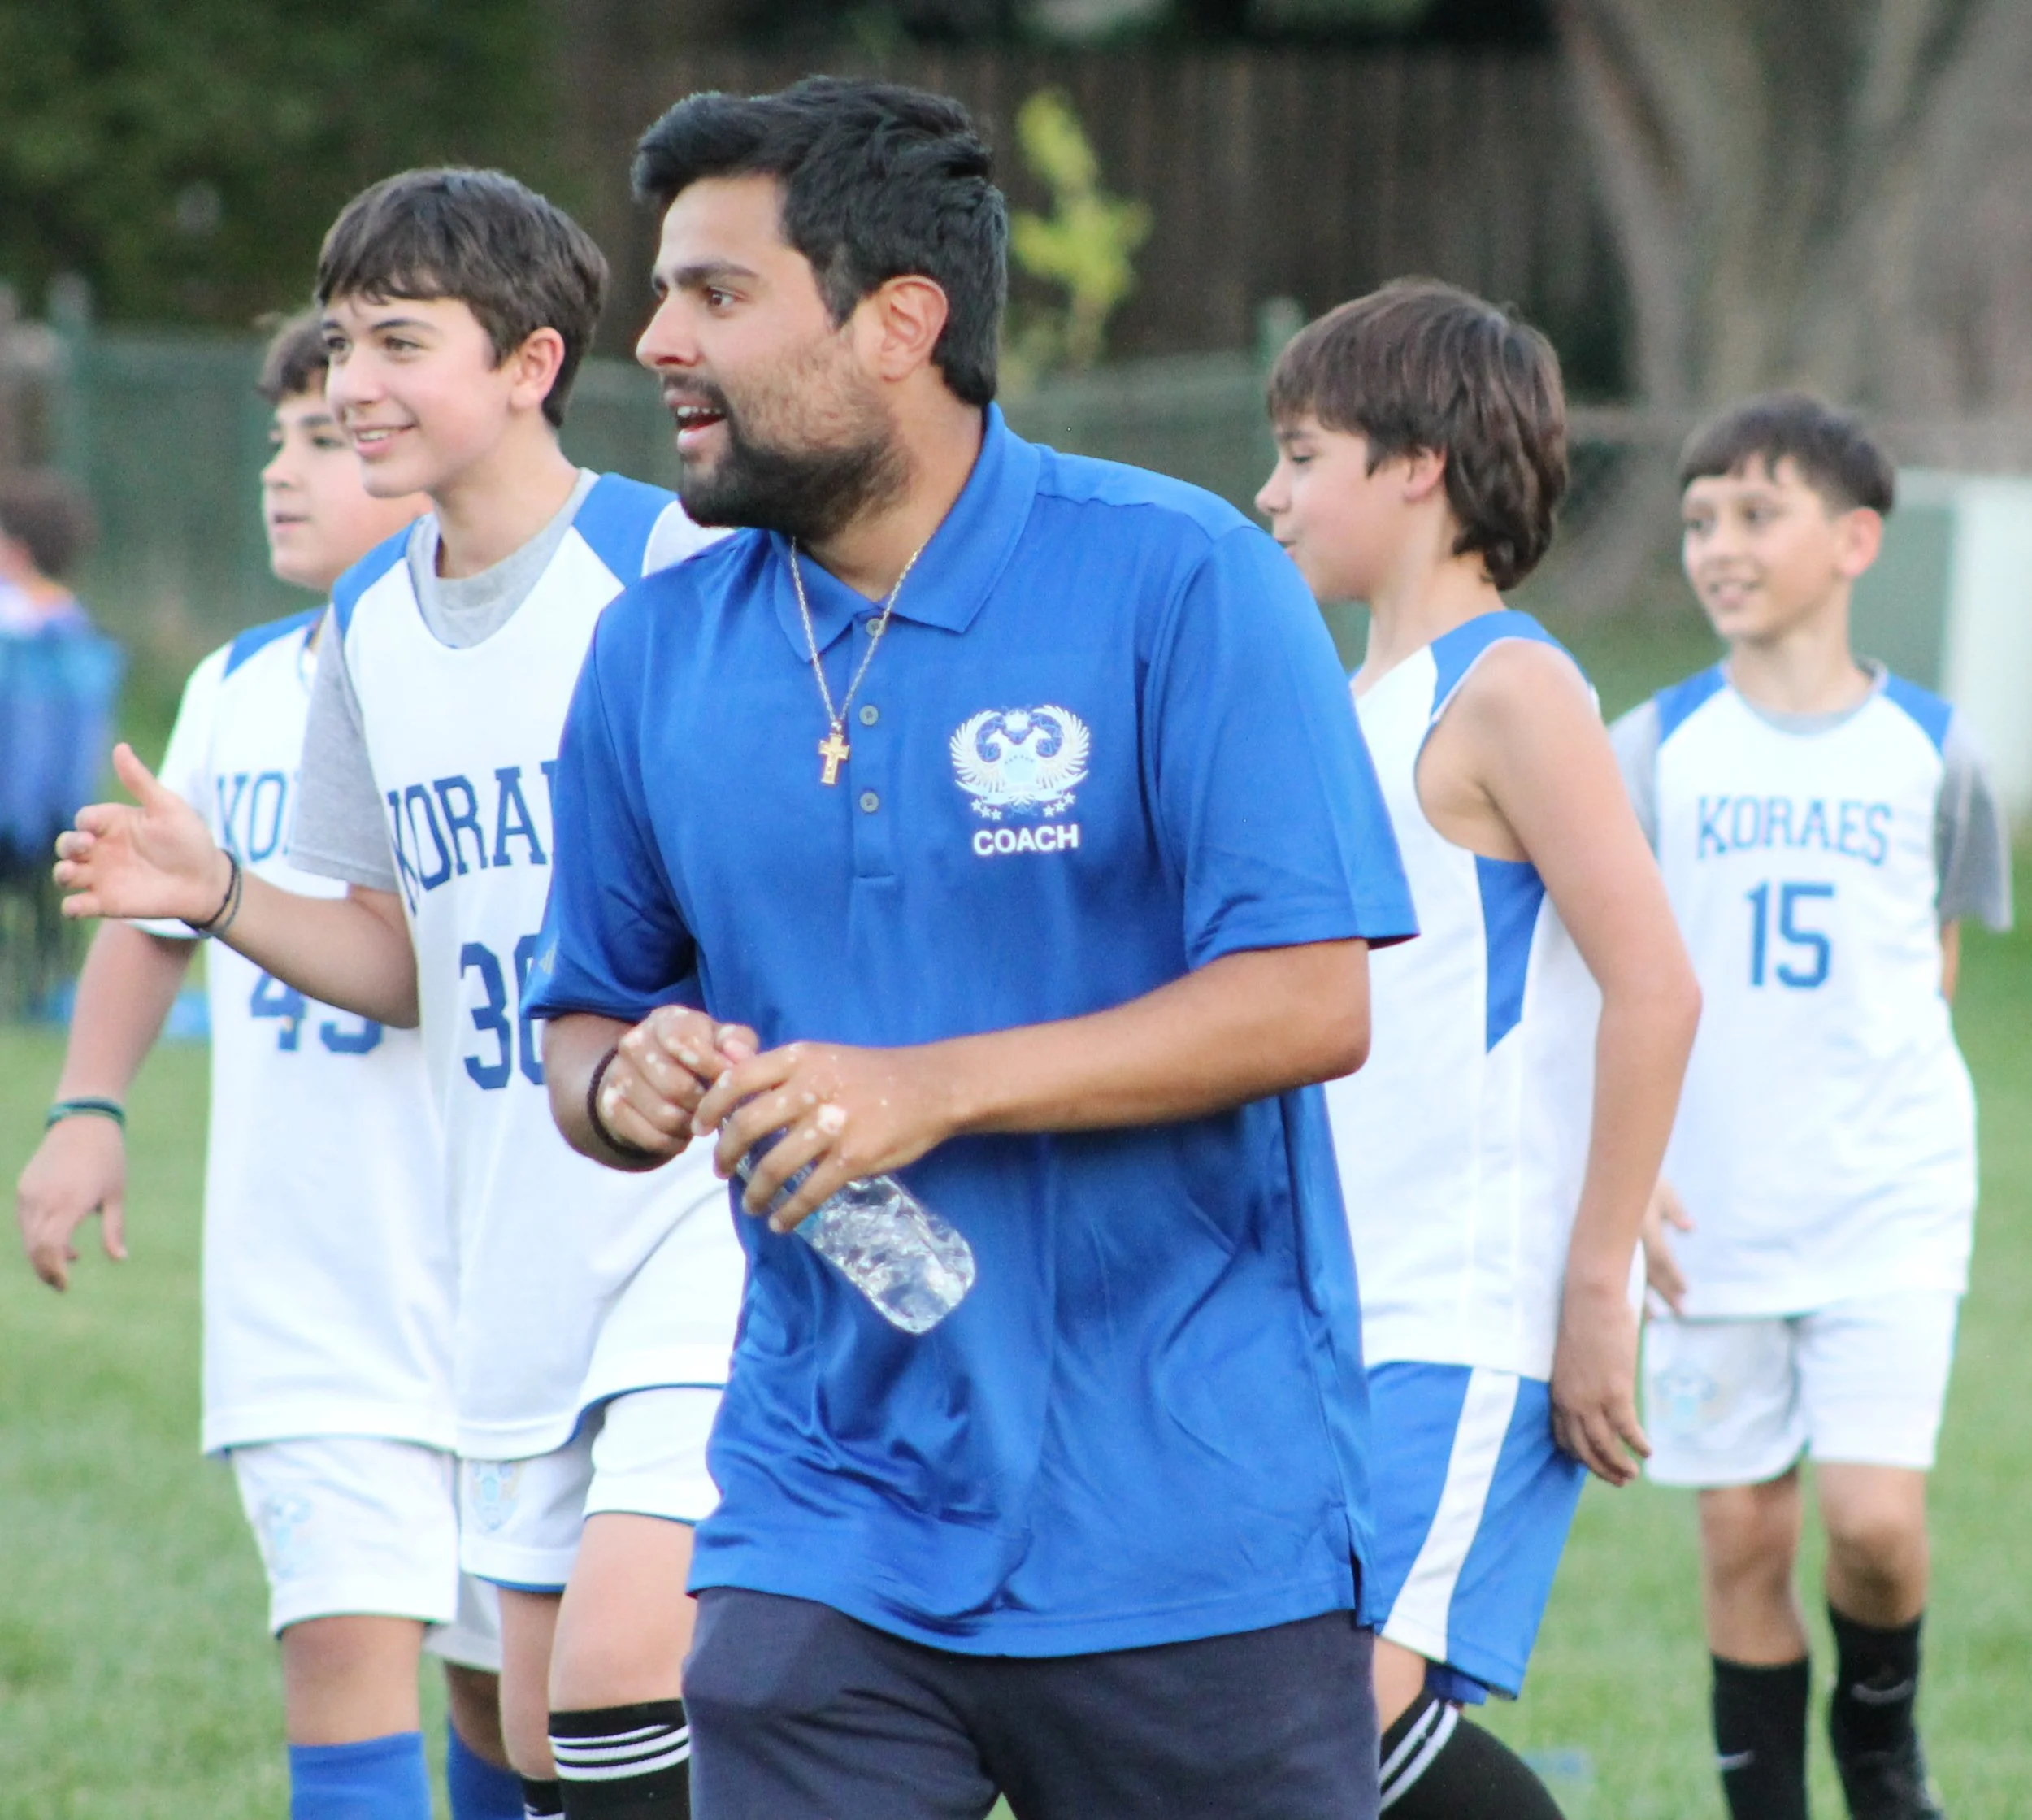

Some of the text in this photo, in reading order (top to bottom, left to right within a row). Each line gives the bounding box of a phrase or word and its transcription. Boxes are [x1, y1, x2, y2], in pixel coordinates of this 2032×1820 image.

[217, 771, 299, 866] KO
[388, 759, 559, 916] KORA
[973, 823, 1079, 855] COACH
[1697, 796, 1892, 866] KORAES
[1745, 880, 1834, 988] 15
